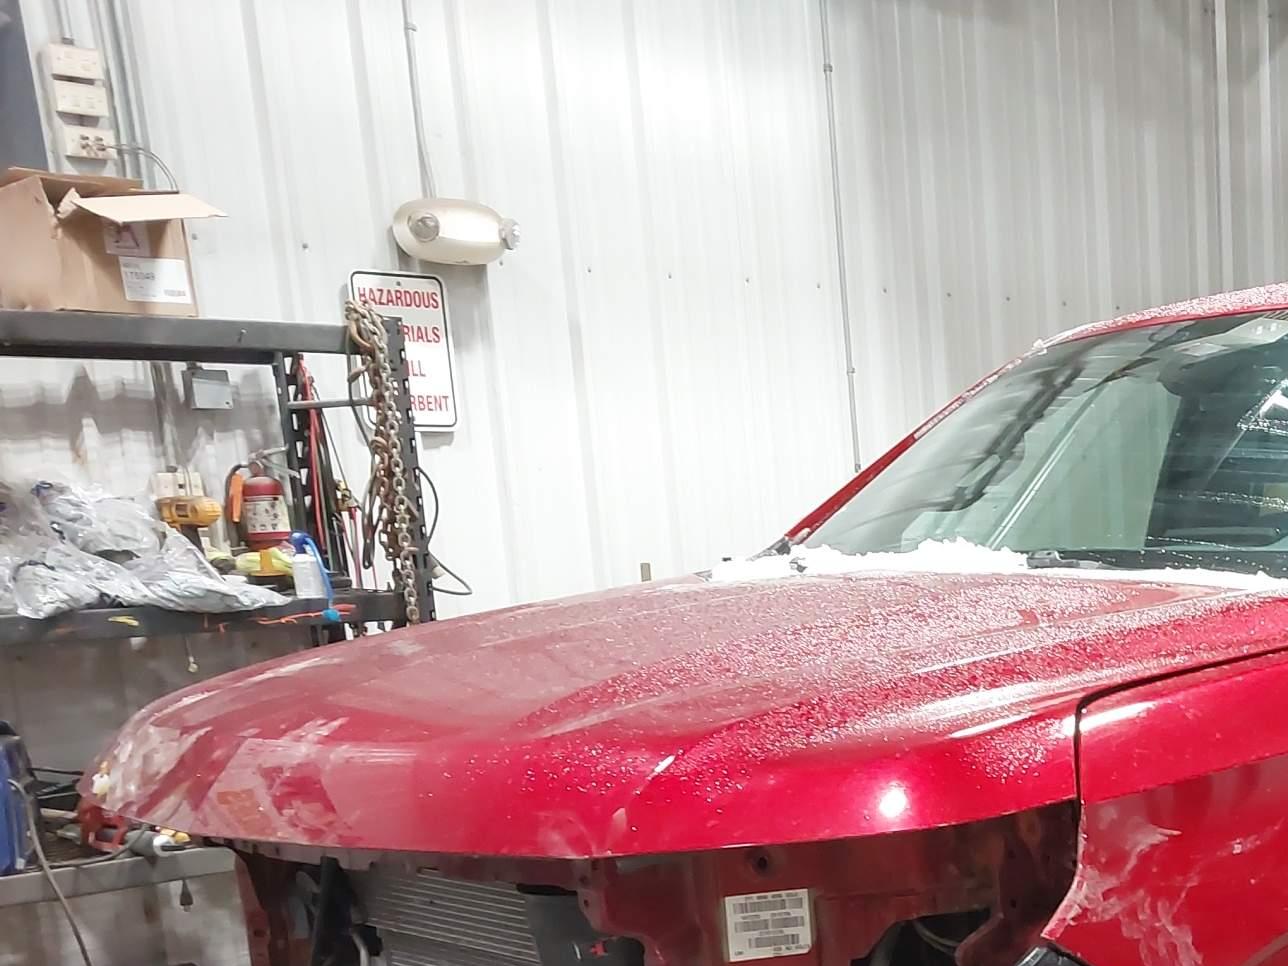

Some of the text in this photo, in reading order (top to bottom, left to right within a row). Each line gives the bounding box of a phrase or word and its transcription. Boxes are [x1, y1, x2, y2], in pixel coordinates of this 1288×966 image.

[358, 287, 439, 309] HAZARDOUS
[402, 325, 440, 343] RIALS
[410, 395, 449, 412] RBENT
